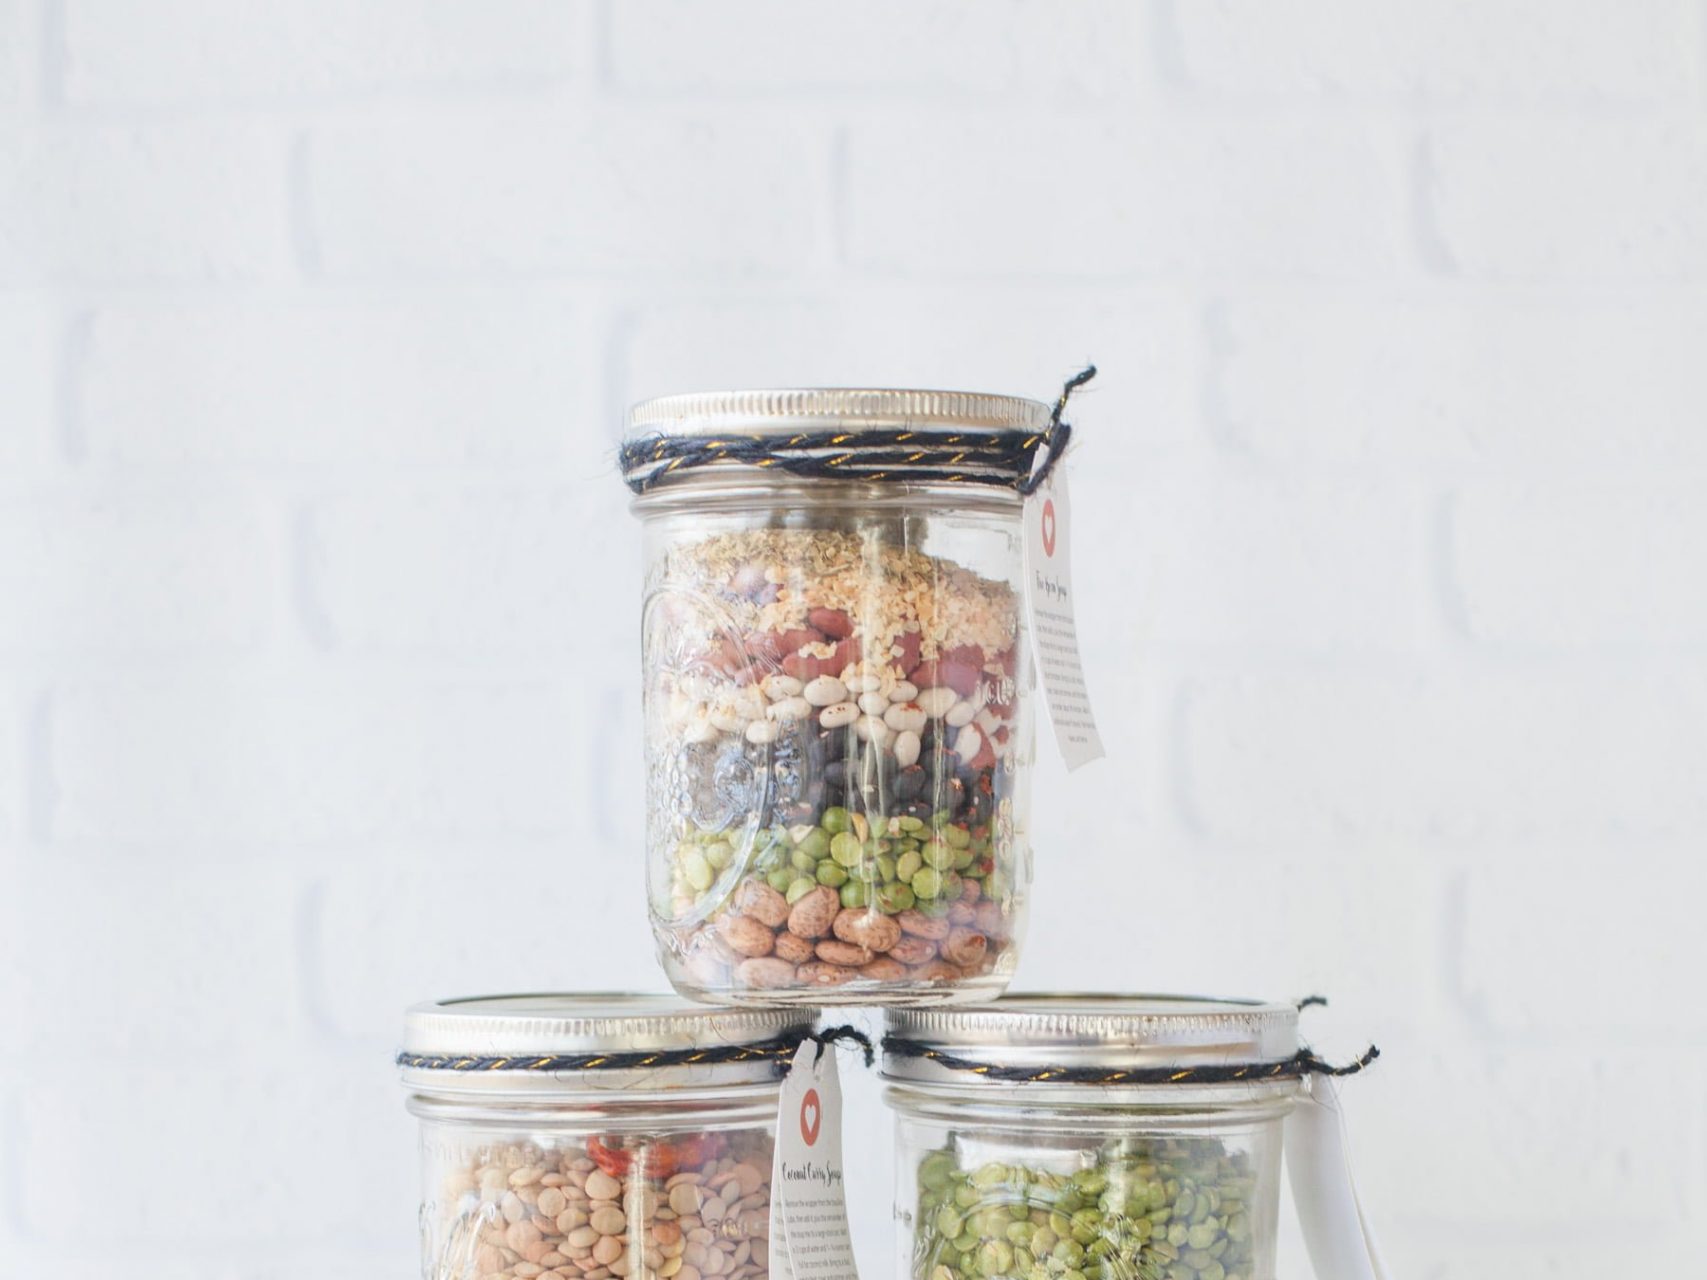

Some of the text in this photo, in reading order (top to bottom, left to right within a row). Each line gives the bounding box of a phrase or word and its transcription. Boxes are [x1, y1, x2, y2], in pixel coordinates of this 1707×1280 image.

[782, 1160, 842, 1188] Coconut Curry Soup
